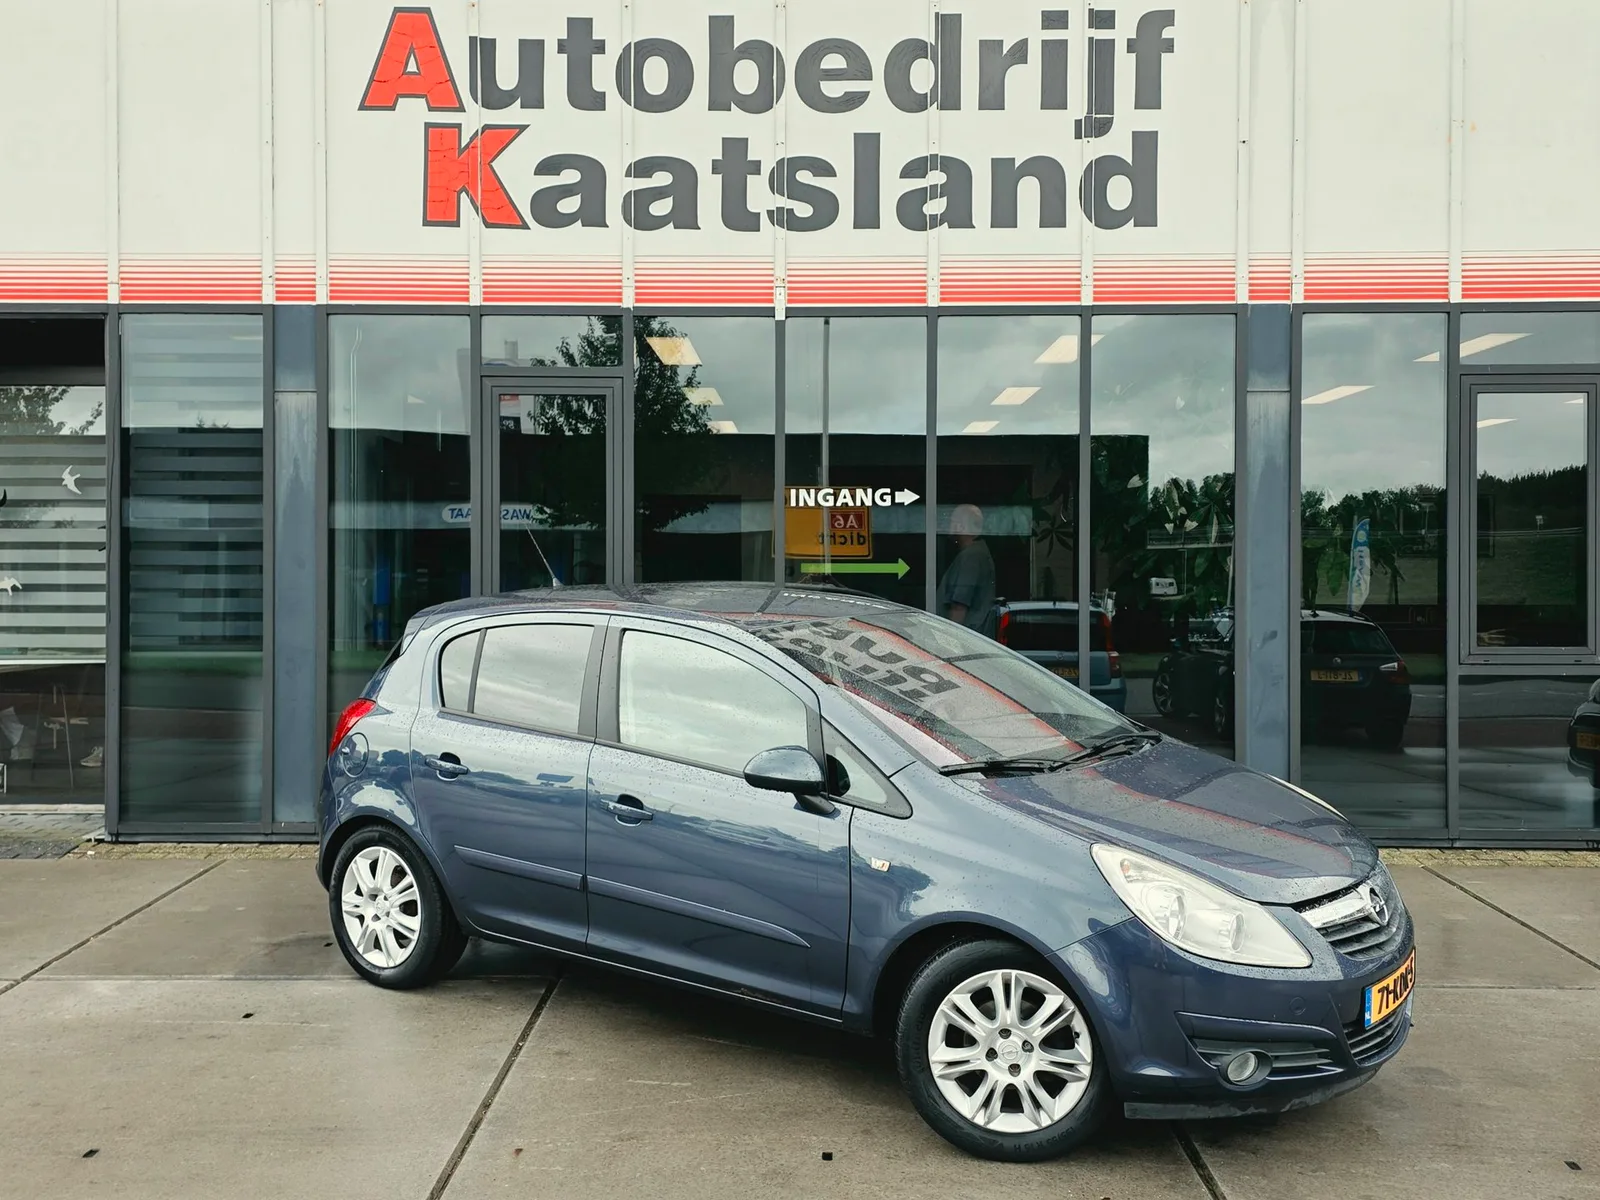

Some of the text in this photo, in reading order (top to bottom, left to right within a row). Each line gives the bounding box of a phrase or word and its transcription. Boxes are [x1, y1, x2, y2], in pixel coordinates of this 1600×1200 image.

[358, 7, 1176, 138] Autobedrijf
[422, 122, 1160, 231] Kaatsland
[790, 488, 892, 507] INGANG
